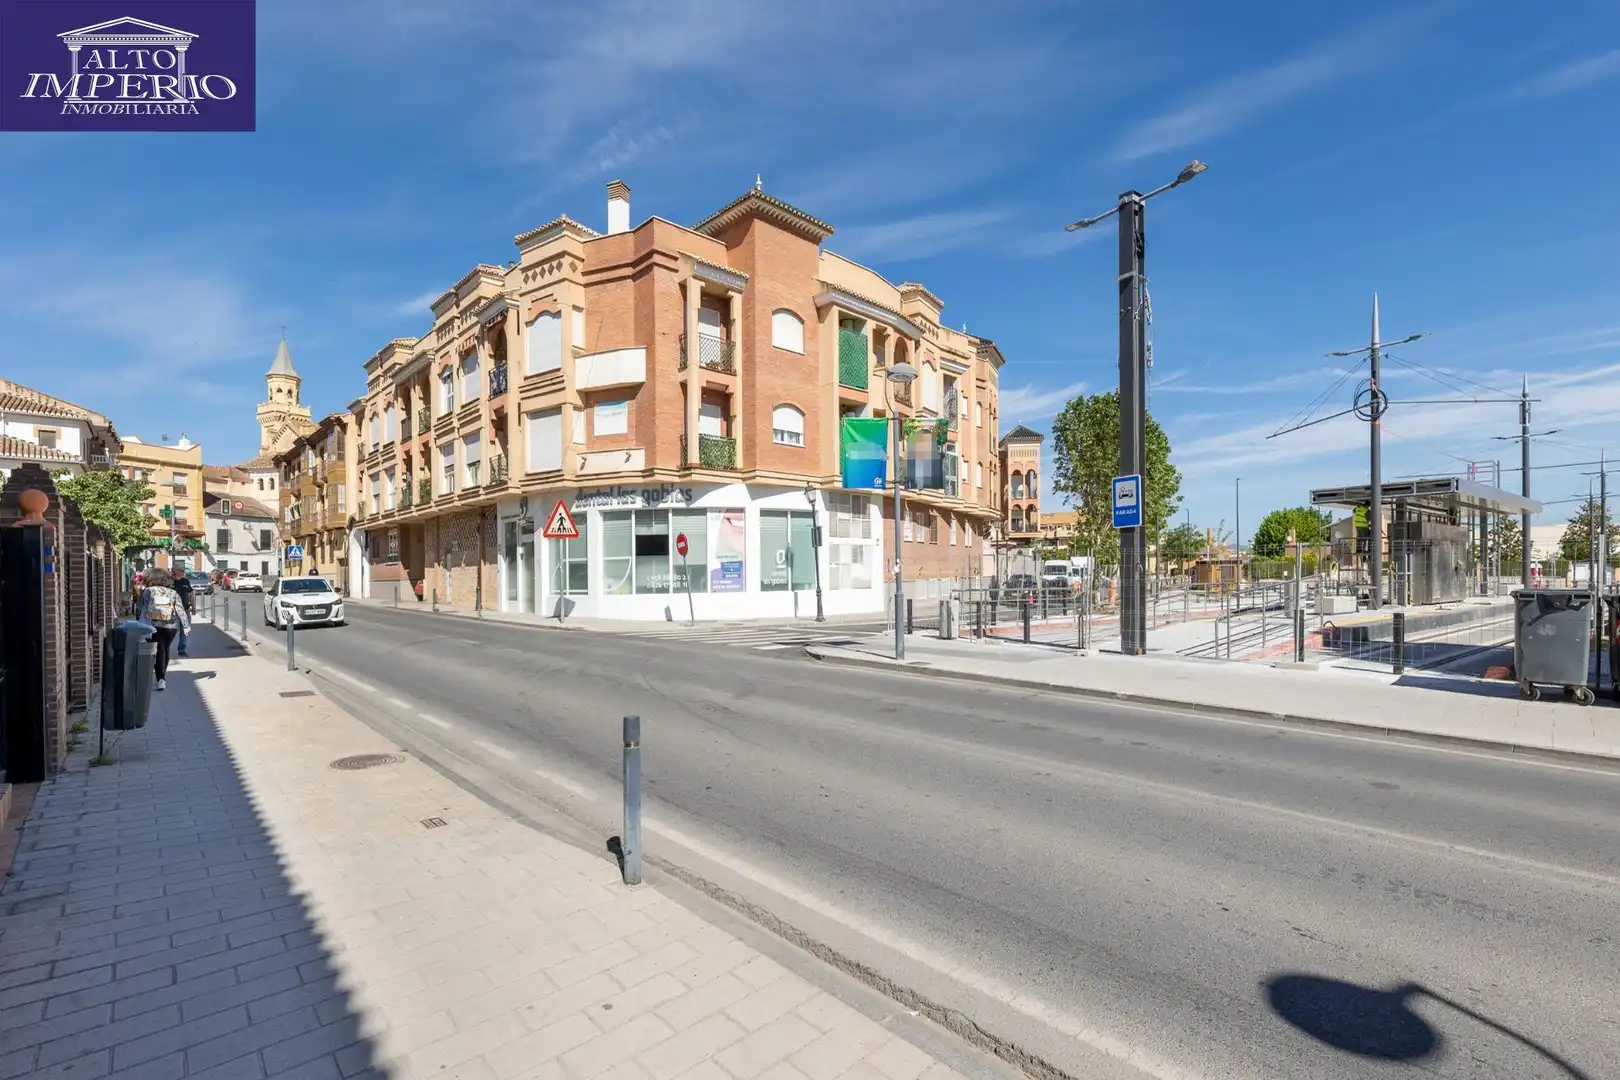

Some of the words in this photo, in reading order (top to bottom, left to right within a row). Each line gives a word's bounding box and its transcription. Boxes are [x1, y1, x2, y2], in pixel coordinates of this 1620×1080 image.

[575, 485, 613, 508] dental
[617, 485, 637, 505] las
[641, 483, 693, 508] gabias
